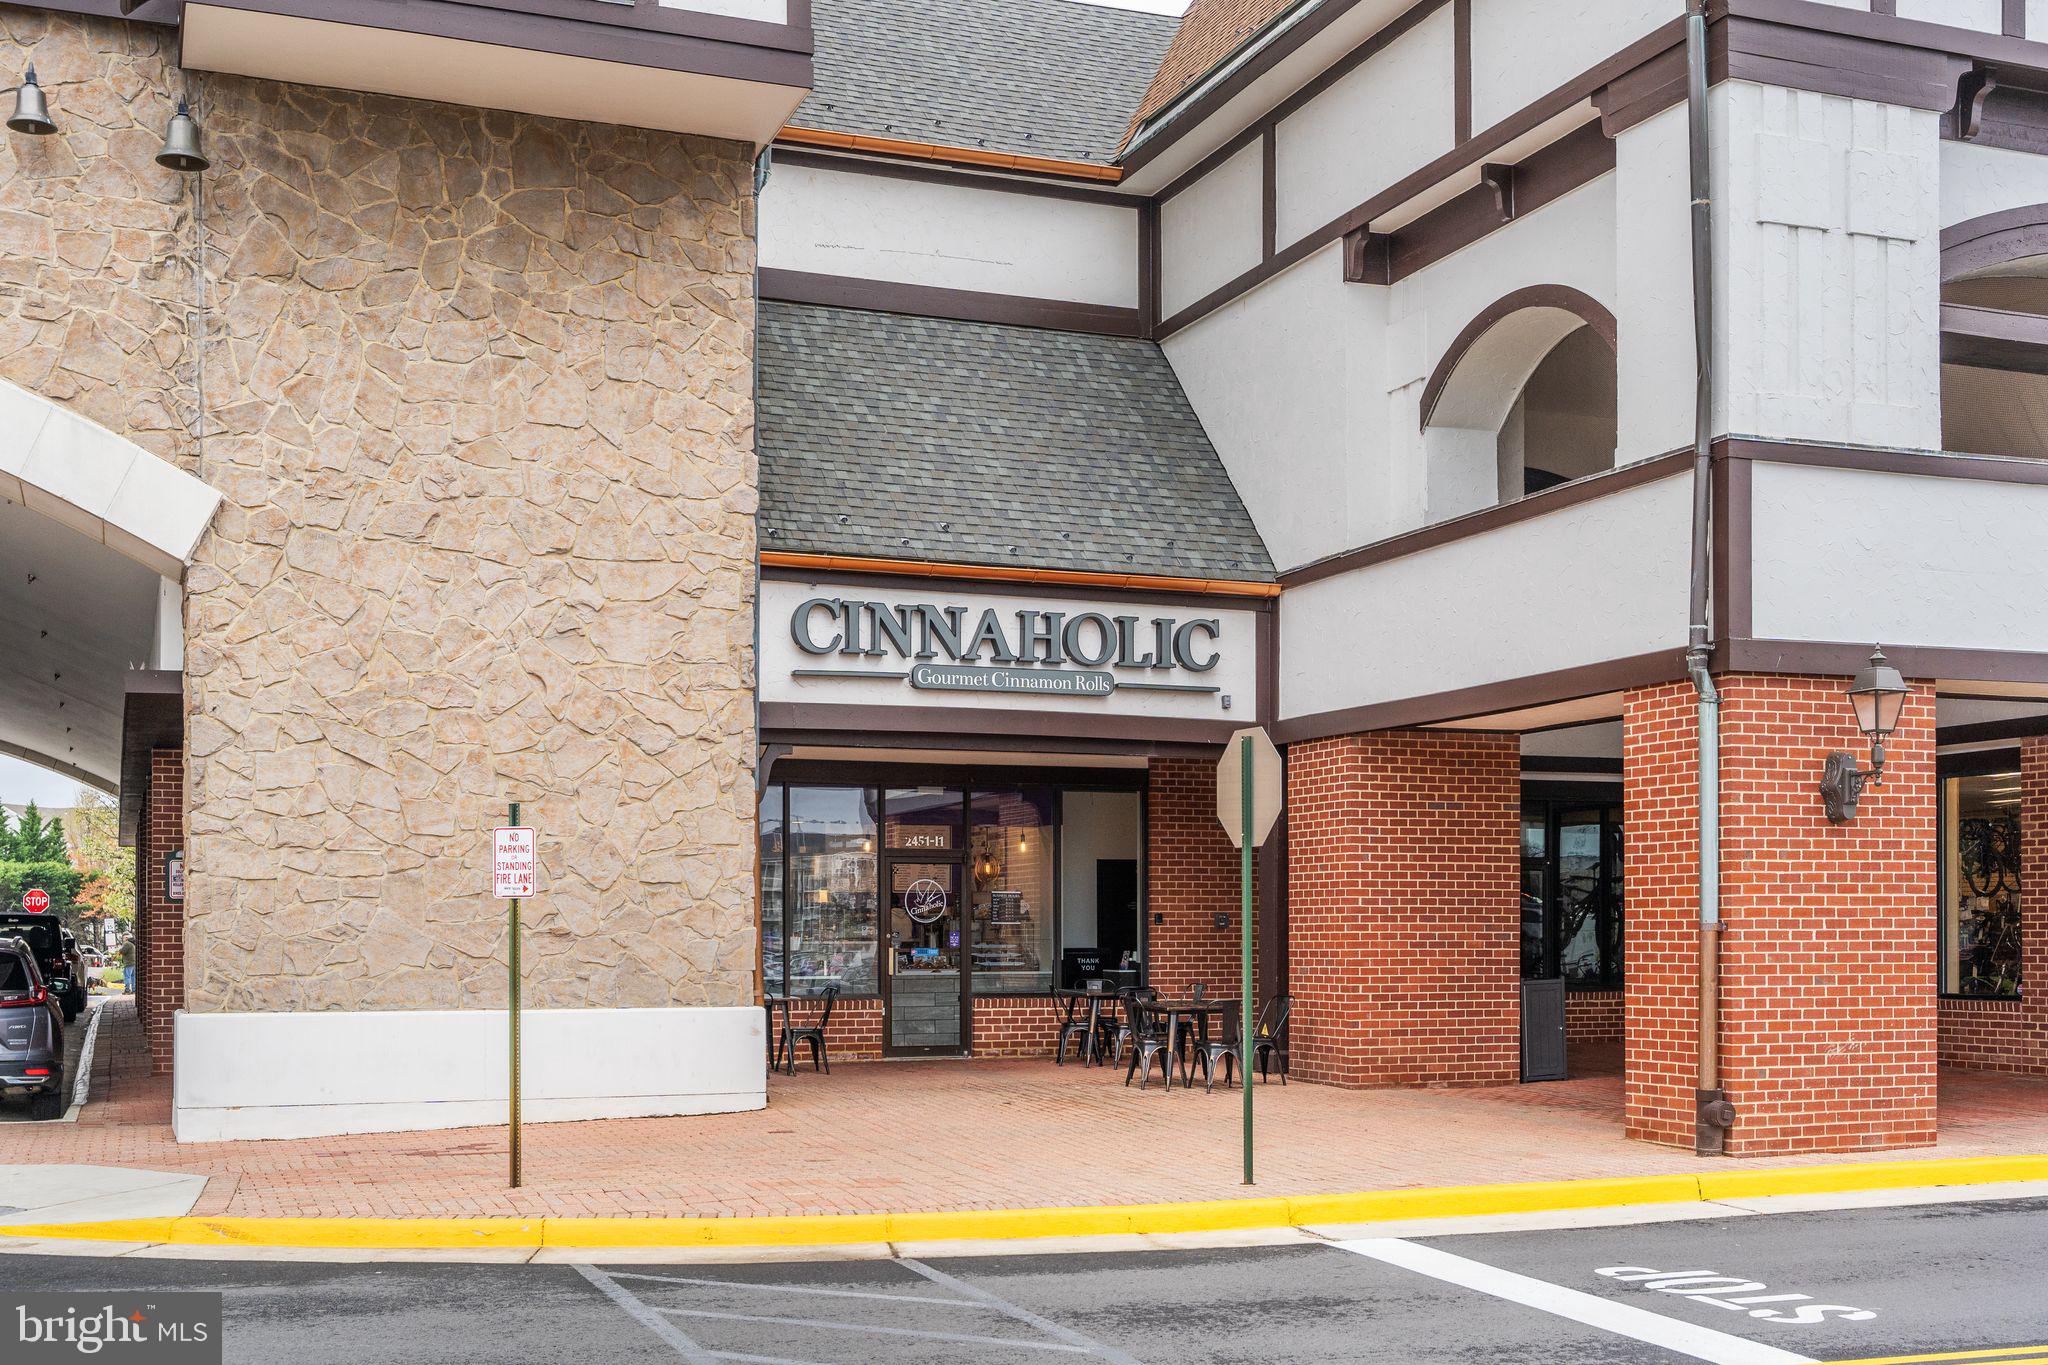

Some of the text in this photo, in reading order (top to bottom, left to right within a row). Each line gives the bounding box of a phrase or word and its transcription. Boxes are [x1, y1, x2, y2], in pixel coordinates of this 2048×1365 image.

[790, 597, 1221, 673] CINNAHOLIC
[917, 667, 1110, 694] Gourmet Cinnamon Rolls
[509, 833, 519, 842] NO
[499, 845, 530, 853] PARKING
[497, 862, 532, 871] STANDING
[497, 874, 532, 884] FIRE LANE
[25, 896, 48, 906] STOP
[1594, 1266, 1878, 1324] STOP
